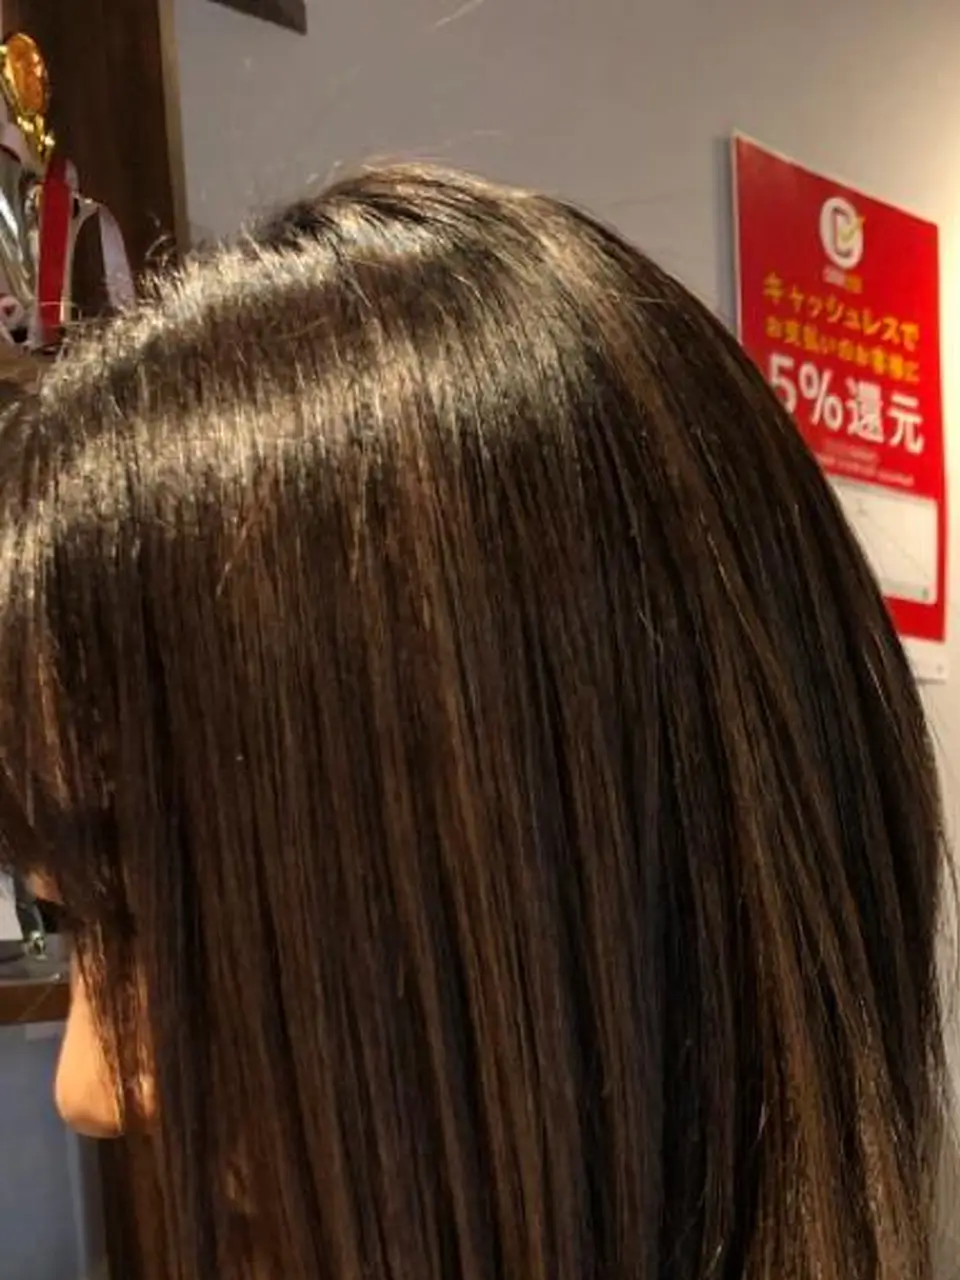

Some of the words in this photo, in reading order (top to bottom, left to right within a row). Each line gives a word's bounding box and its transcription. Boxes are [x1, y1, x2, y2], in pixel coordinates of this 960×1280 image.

[763, 271, 920, 352] キャッシュレスで
[769, 352, 925, 455] 5%還元
